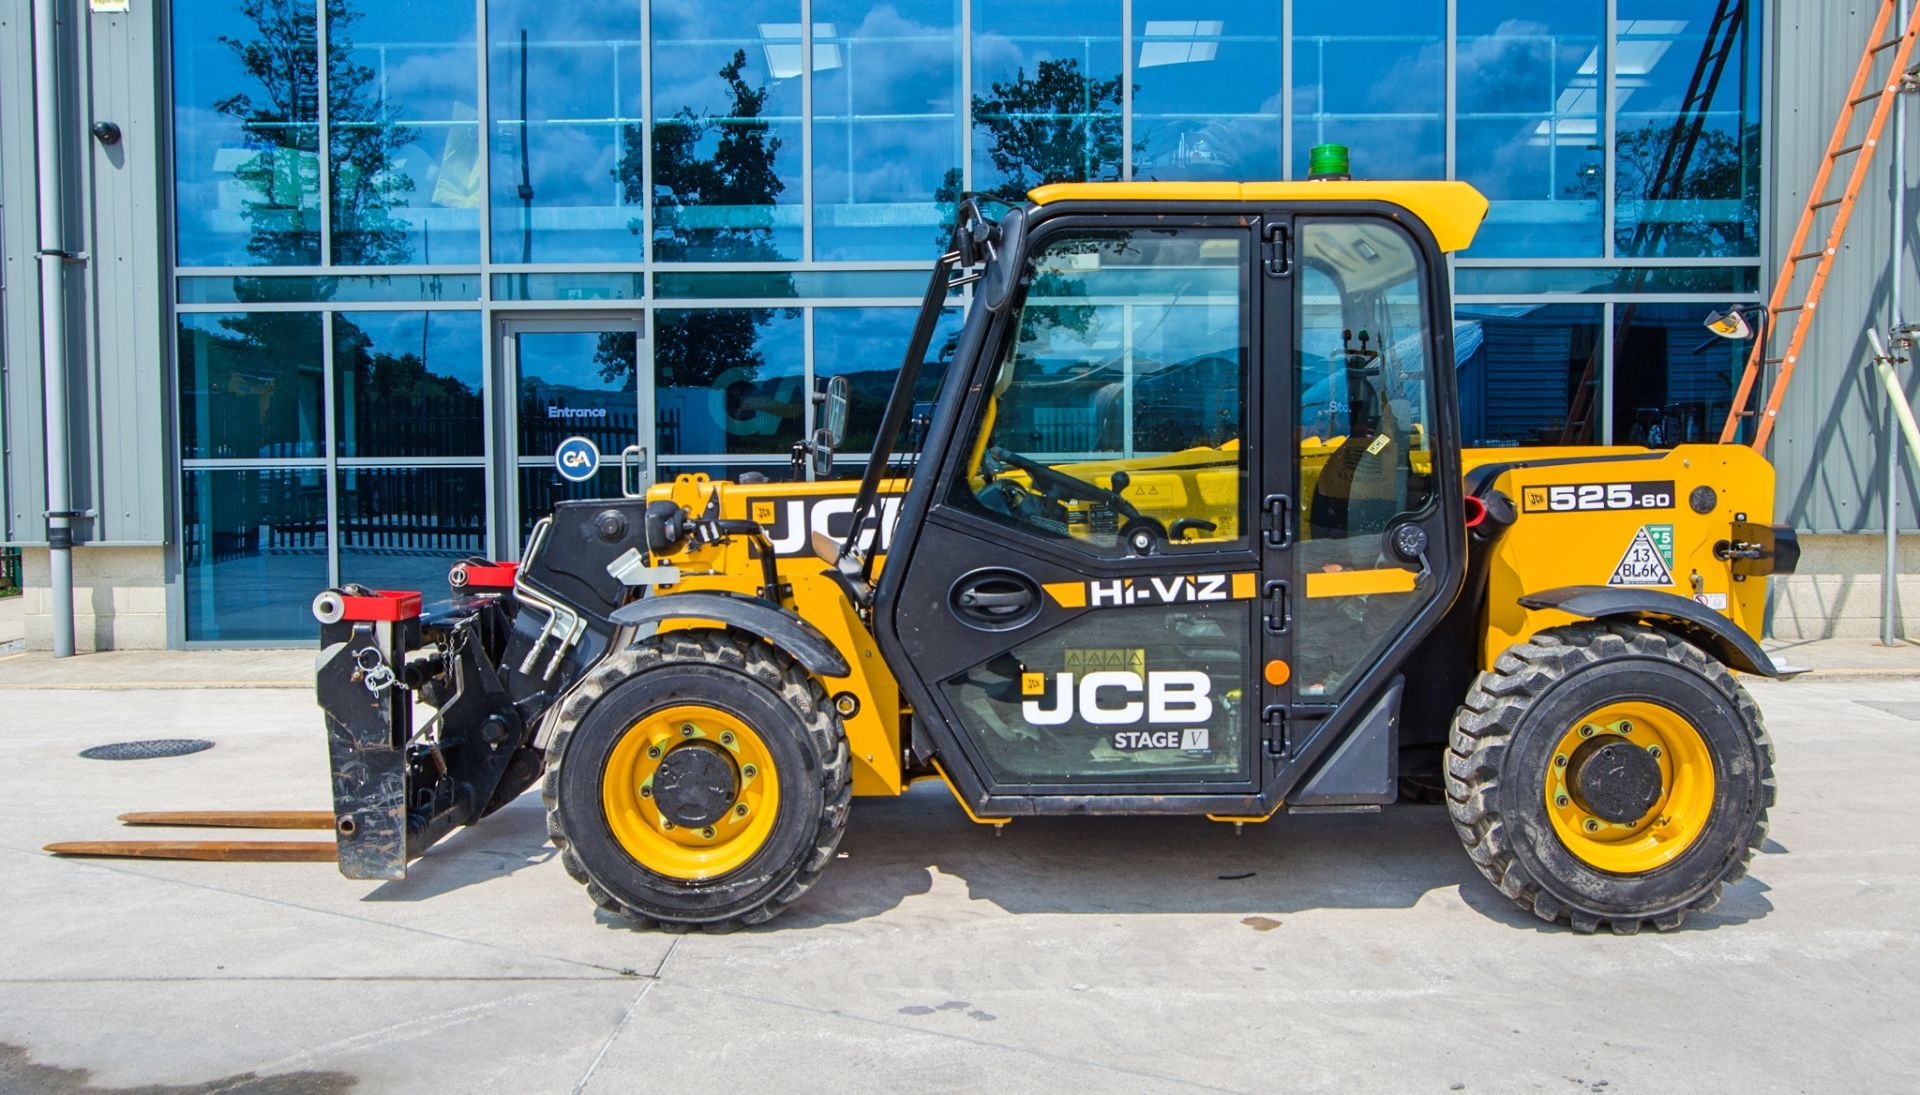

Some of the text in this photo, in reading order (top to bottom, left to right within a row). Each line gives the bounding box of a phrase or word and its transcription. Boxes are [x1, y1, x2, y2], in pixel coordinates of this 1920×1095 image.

[548, 406, 607, 418] Entrance
[562, 450, 592, 468] GA
[1661, 532, 1671, 544] 5
[1632, 548, 1650, 563] 13
[1022, 671, 1213, 725] JCB
[1114, 731, 1202, 748] STAGE V
